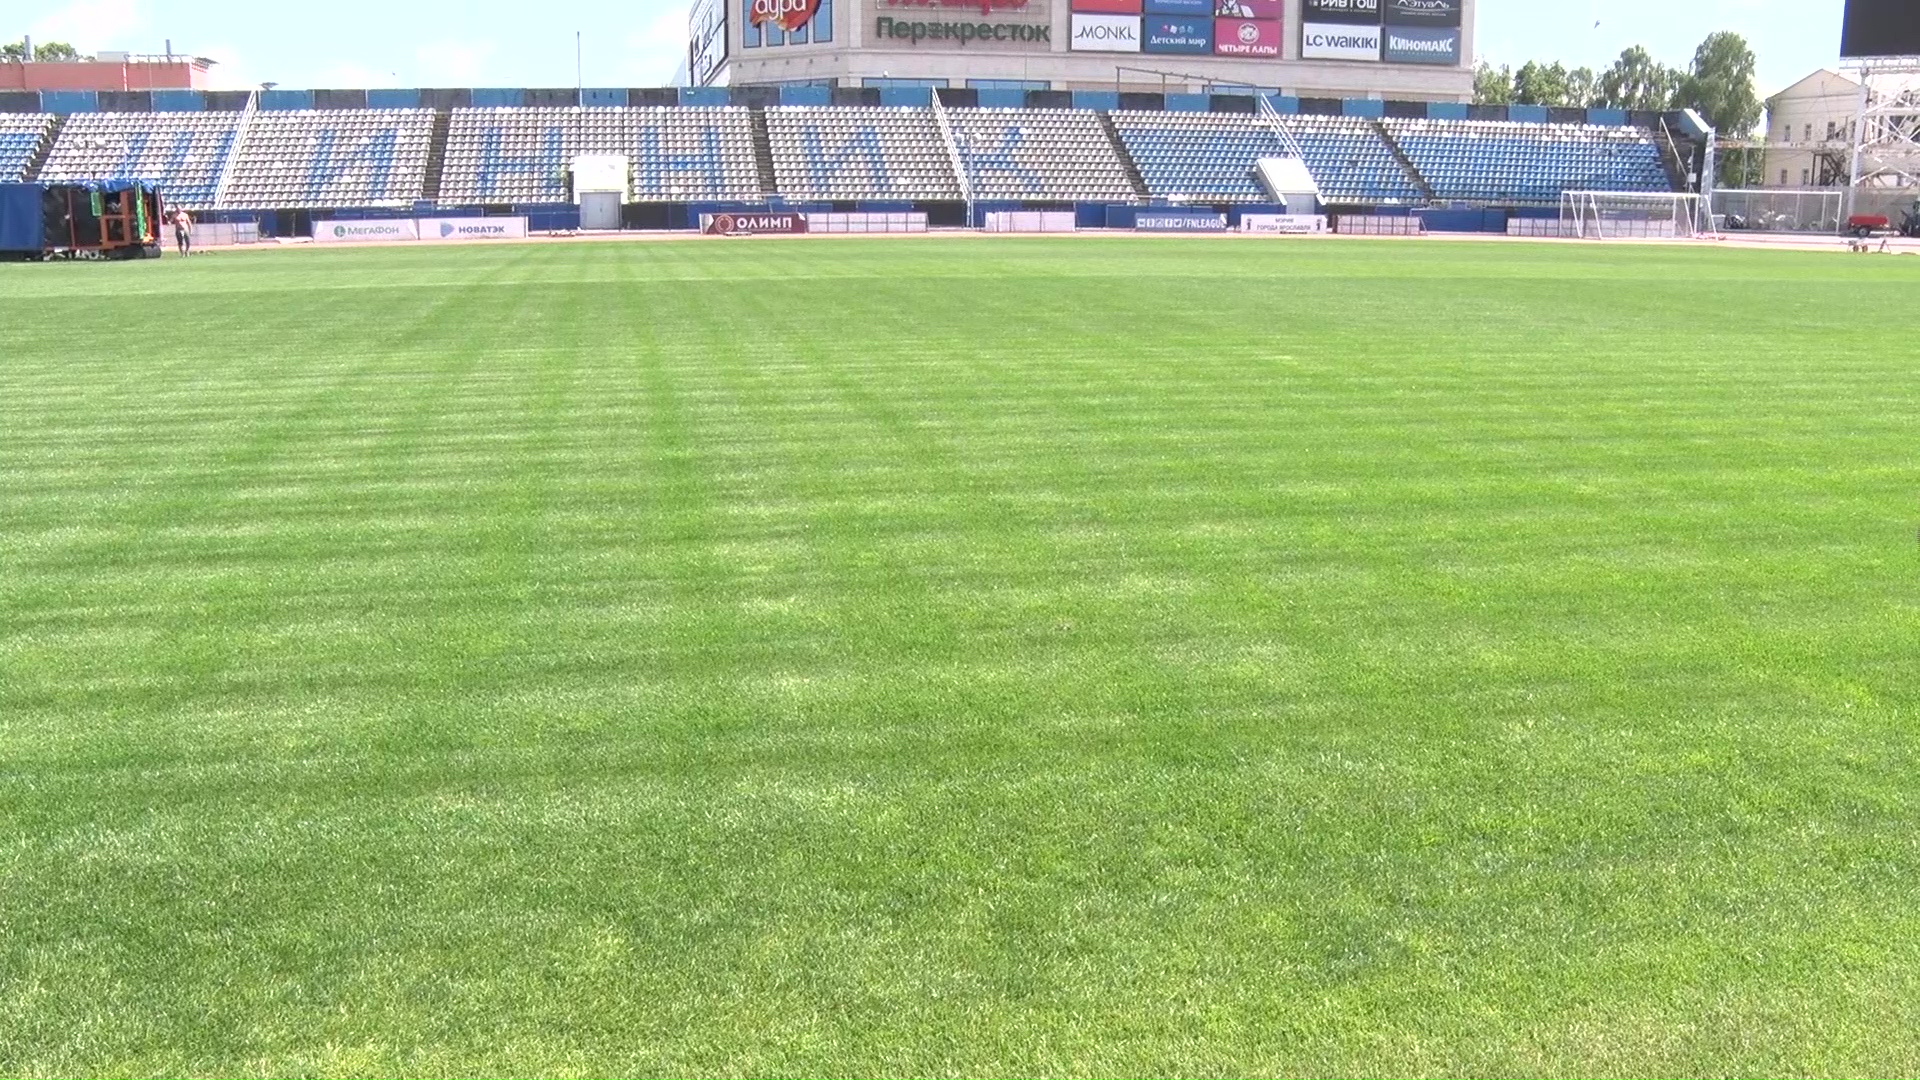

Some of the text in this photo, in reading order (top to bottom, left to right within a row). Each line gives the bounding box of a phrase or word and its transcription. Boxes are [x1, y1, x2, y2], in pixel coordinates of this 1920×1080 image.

[1150, 35, 1206, 47] Детский мир
[1306, 34, 1323, 47] LC
[1218, 44, 1278, 54] ЧЕТЫРЕ ЛАПЫ
[736, 217, 792, 228] ОЛИМП
[458, 225, 505, 234] НОВАТЭК
